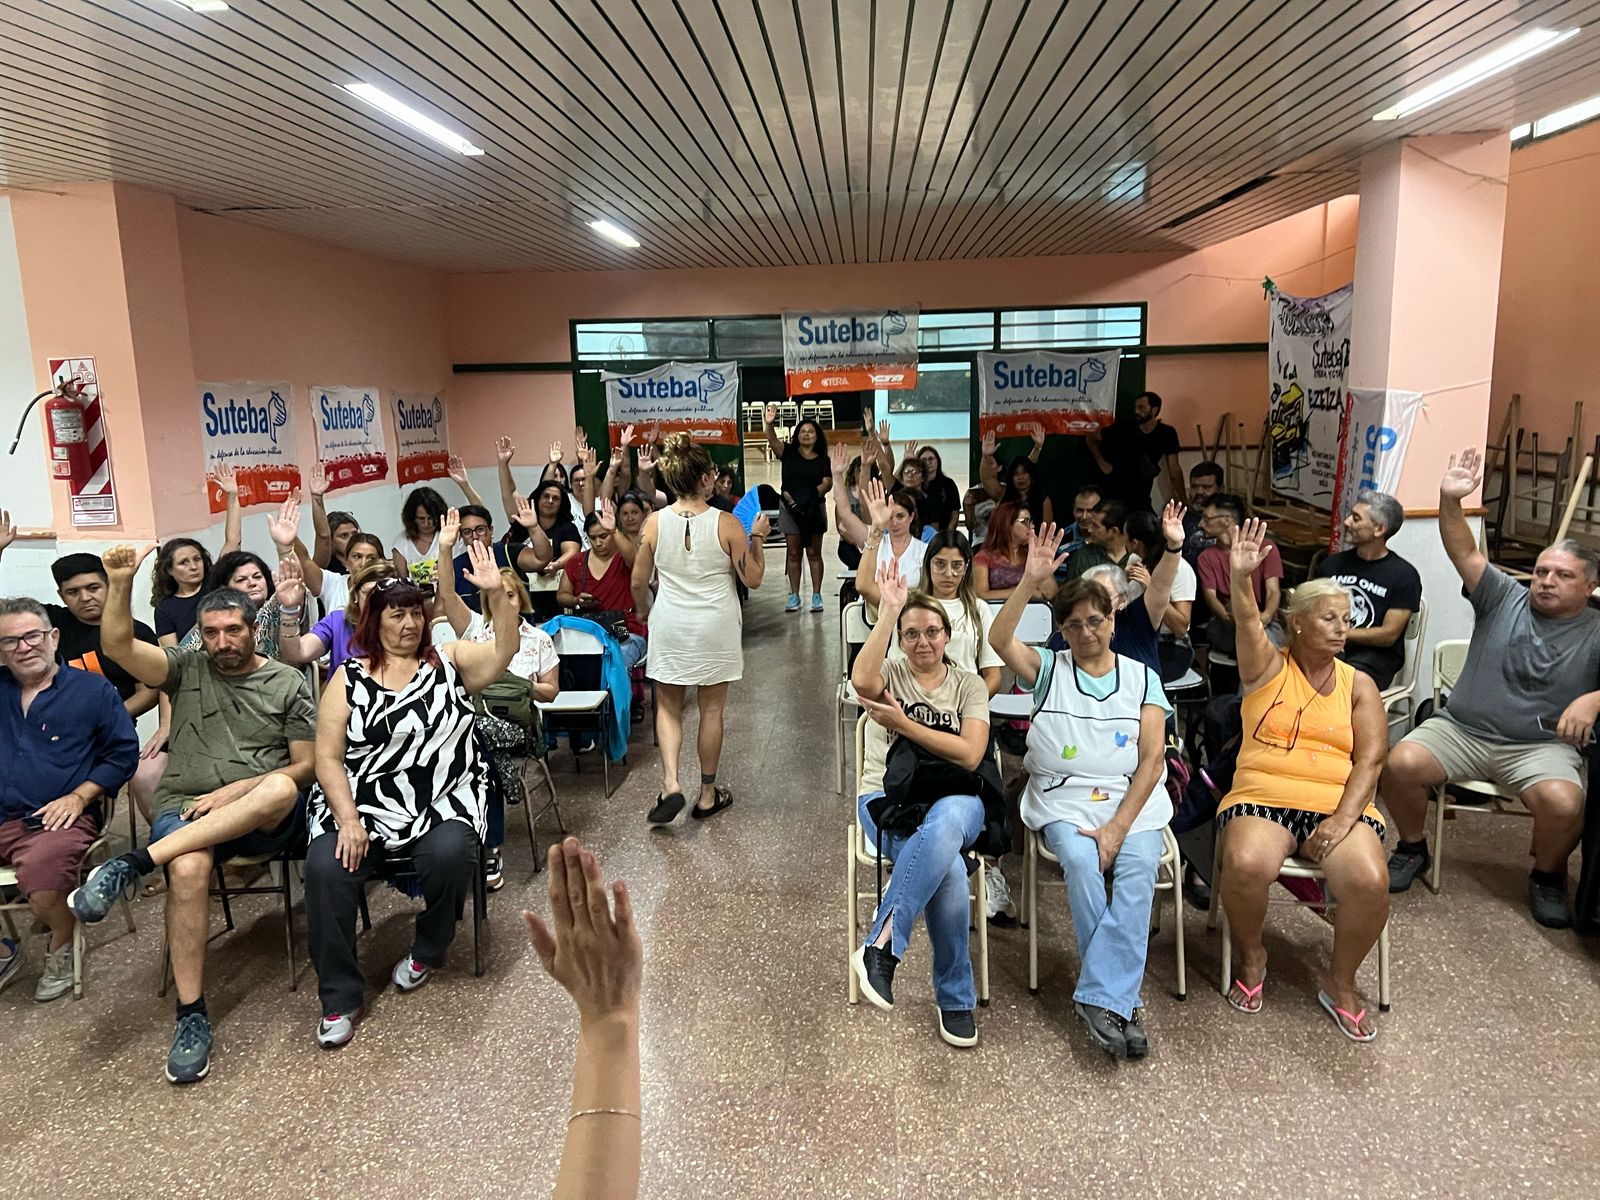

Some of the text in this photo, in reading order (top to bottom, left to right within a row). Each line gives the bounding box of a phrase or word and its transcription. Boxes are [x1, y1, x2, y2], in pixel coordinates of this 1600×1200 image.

[798, 315, 879, 346] Suteba
[1313, 340, 1342, 369] Suteba
[618, 376, 698, 399] Suteba
[993, 360, 1077, 390] Suteba
[203, 392, 269, 437] Suteba
[320, 394, 363, 431] Suteba
[398, 399, 433, 430] Suteba
[1330, 575, 1388, 598] AND ONE
